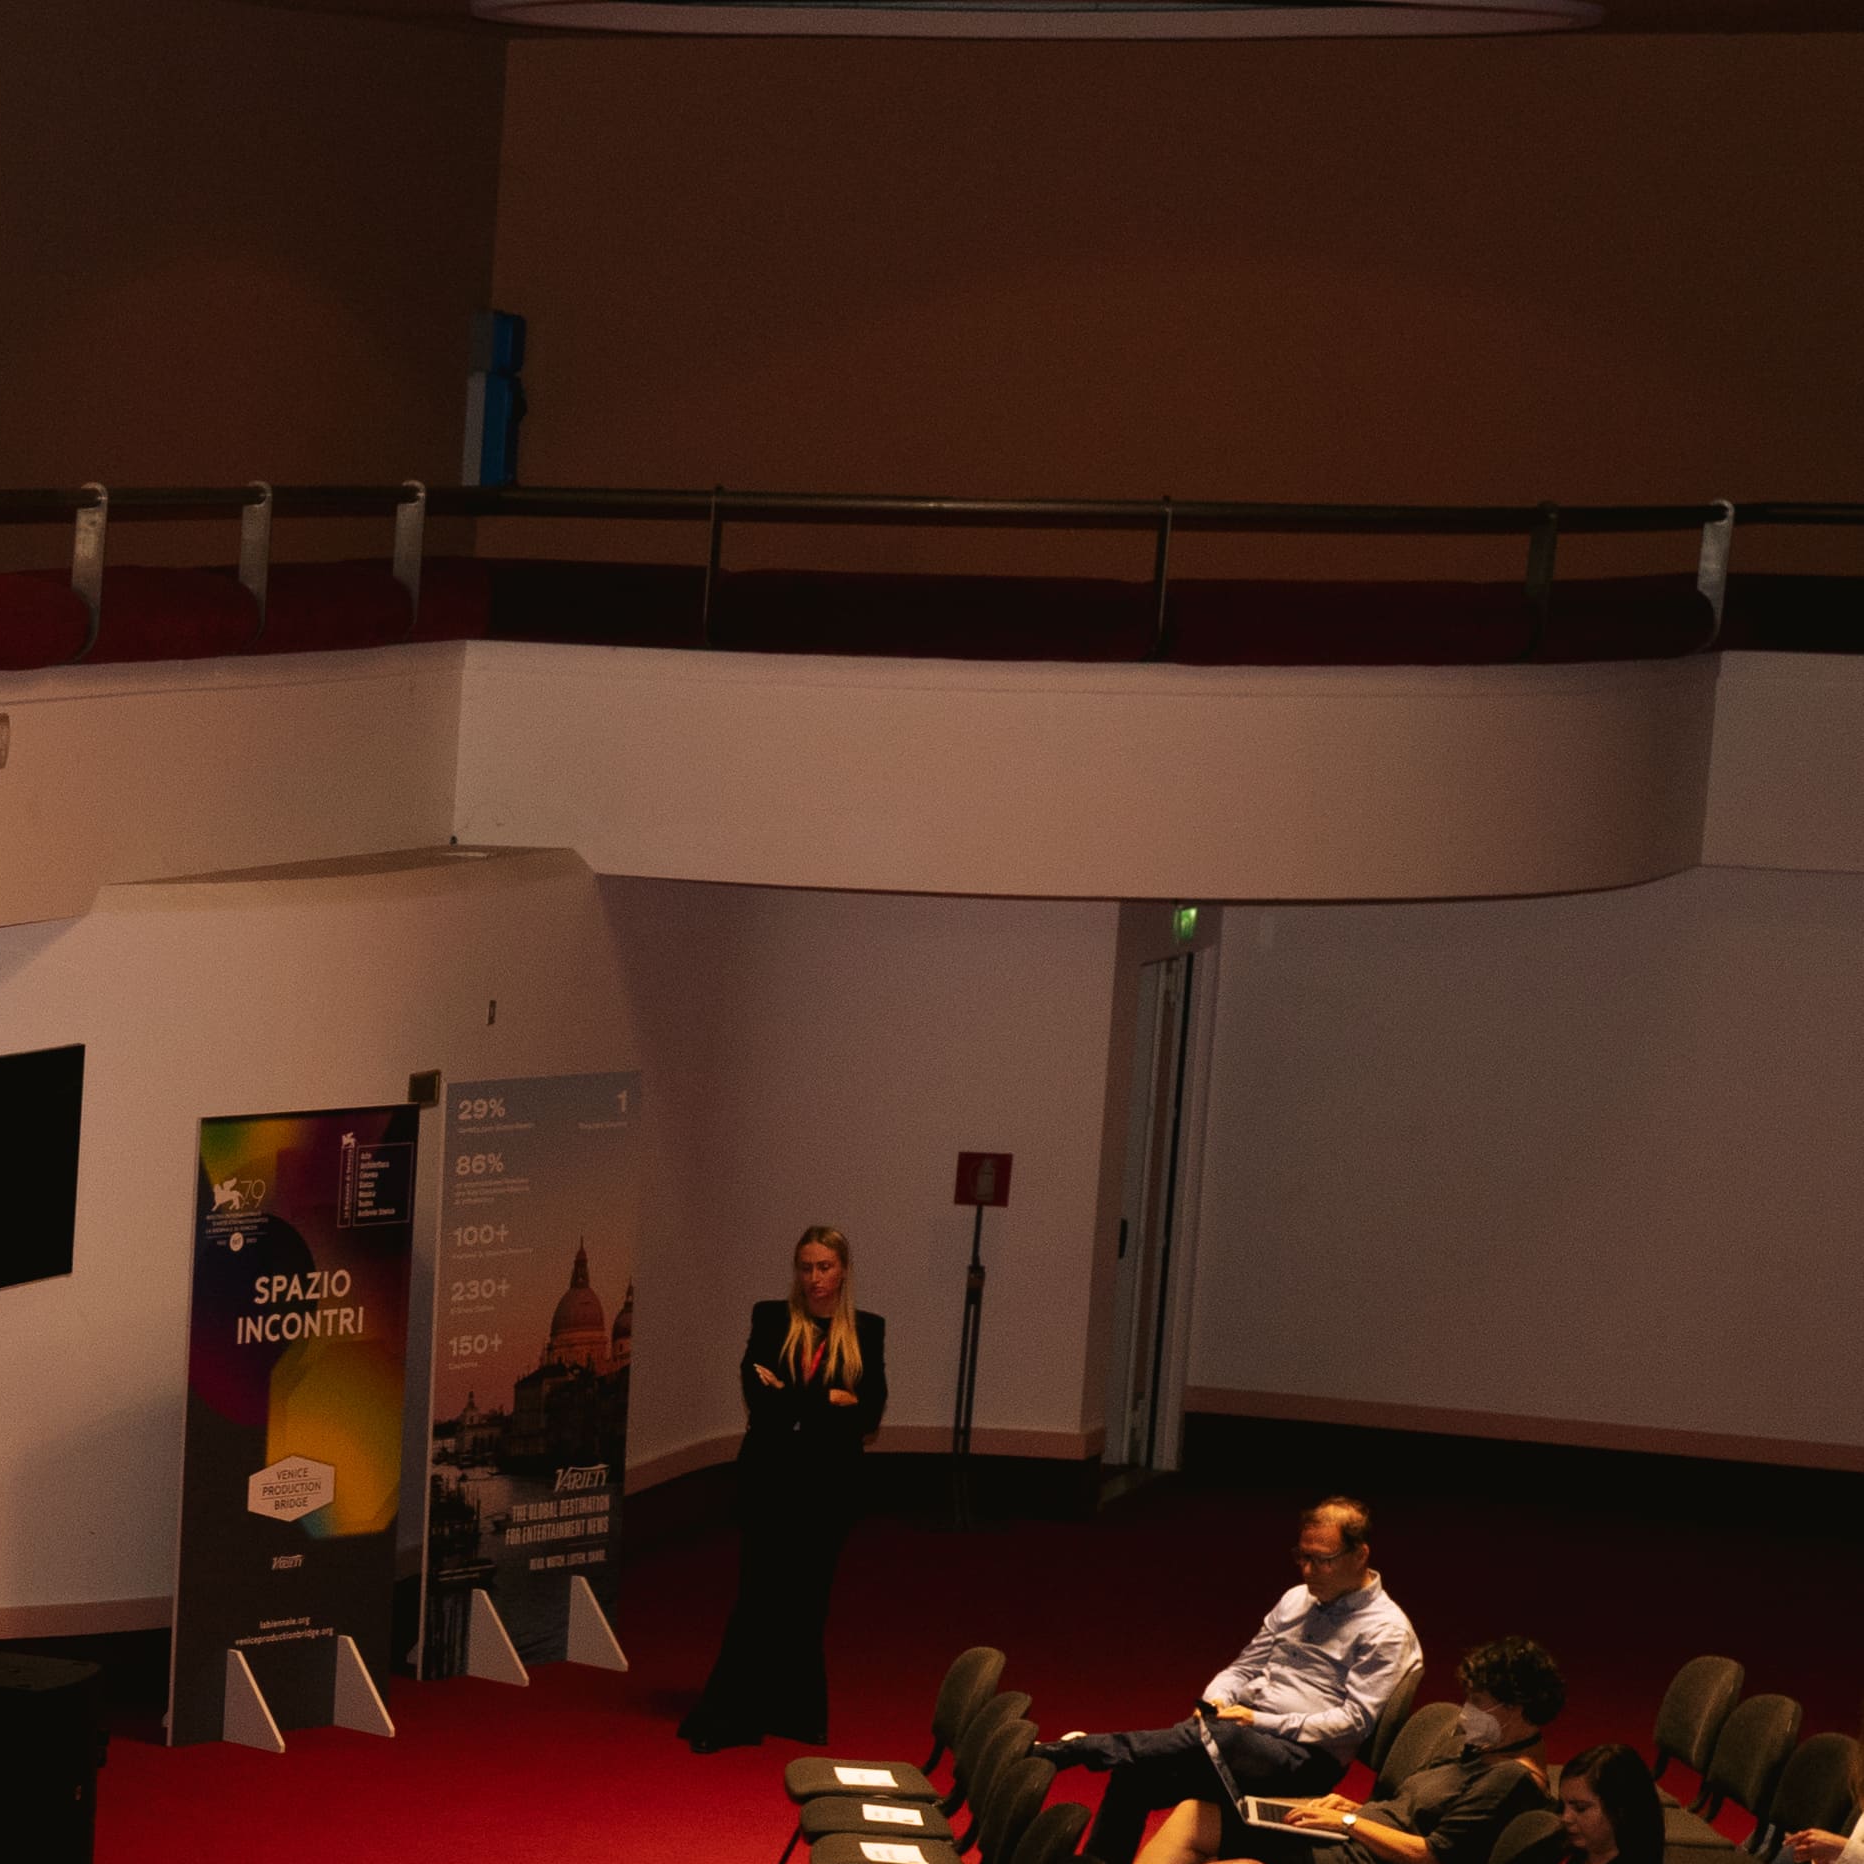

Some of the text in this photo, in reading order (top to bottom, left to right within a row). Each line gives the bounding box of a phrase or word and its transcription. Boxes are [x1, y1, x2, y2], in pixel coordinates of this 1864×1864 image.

[458, 1098, 506, 1121] 29%
[455, 1153, 504, 1175] 86%
[240, 1179, 266, 1209] 79
[453, 1224, 509, 1246] 100+
[254, 1269, 351, 1305] SPAZIO
[451, 1278, 510, 1302] 230+
[237, 1306, 364, 1345] INCONTRI
[448, 1333, 503, 1356] 150+
[276, 1467, 309, 1481] VENICE
[554, 1463, 609, 1493] VARIETY
[262, 1481, 322, 1498] PRODUCTION
[274, 1496, 309, 1511] BRIDGE
